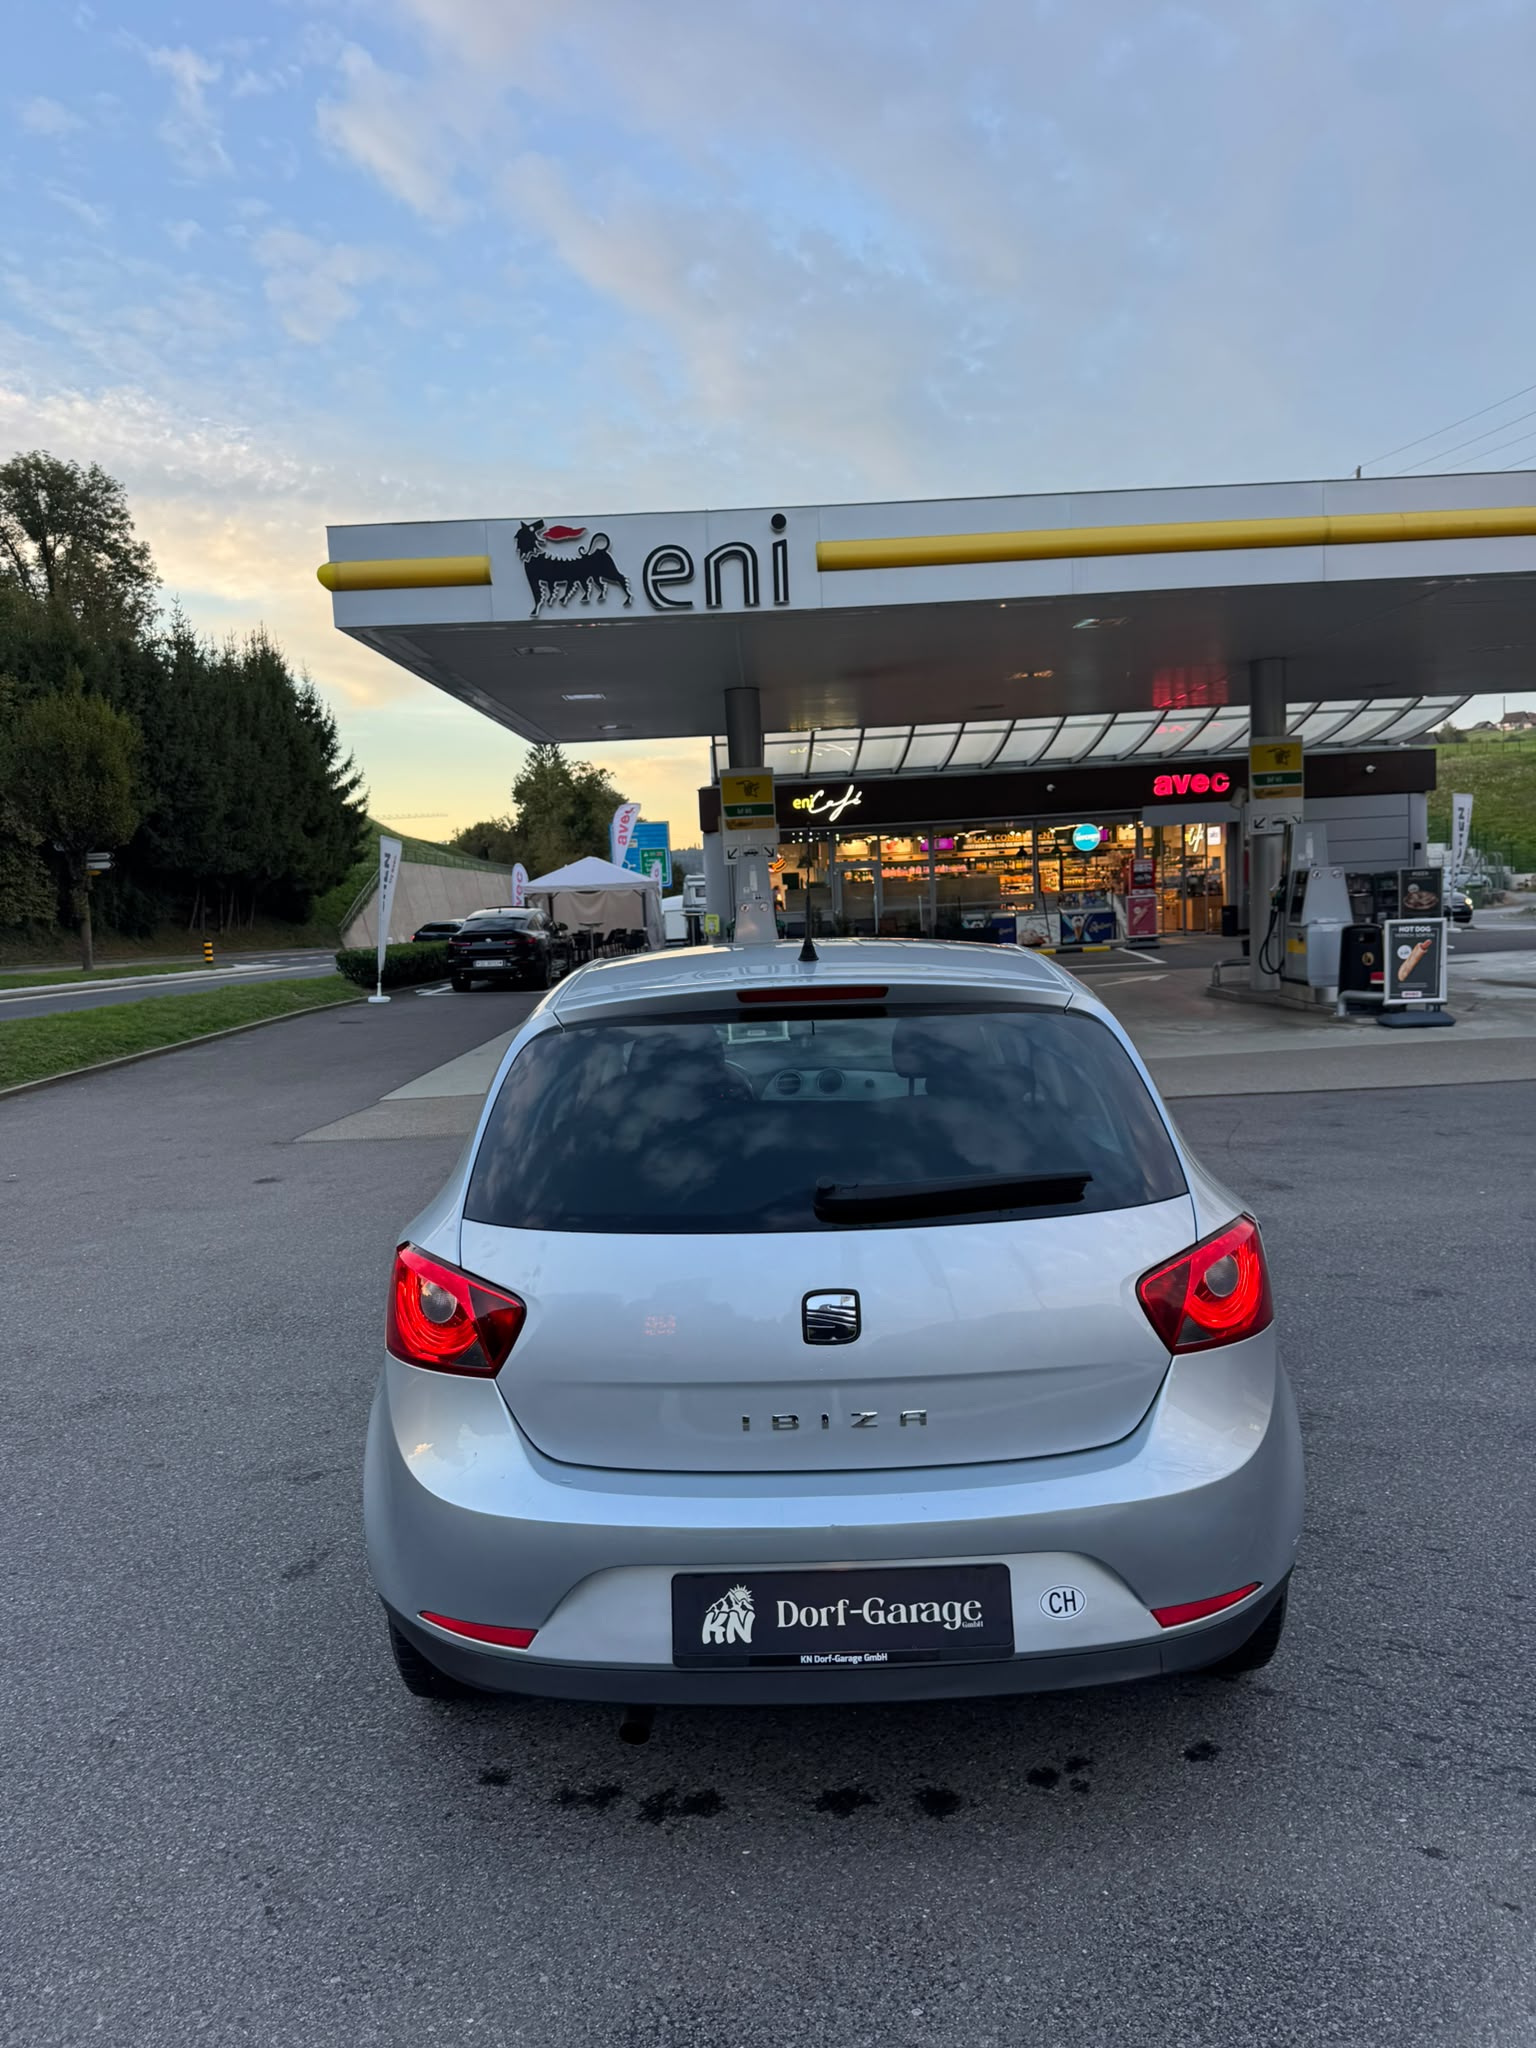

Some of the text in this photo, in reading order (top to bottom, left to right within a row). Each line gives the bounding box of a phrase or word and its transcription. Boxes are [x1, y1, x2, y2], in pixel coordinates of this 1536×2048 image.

[642, 513, 790, 610] eni
[1153, 772, 1231, 797] avec
[792, 795, 814, 809] eni
[1415, 925, 1431, 933] DOG
[741, 1409, 928, 1432] IBIZA
[777, 1596, 983, 1630] Dorf-Garage
[1049, 1590, 1077, 1615] CH
[702, 1609, 756, 1645] KN
[800, 1652, 888, 1665] KN Dorf-Garage GmbH
